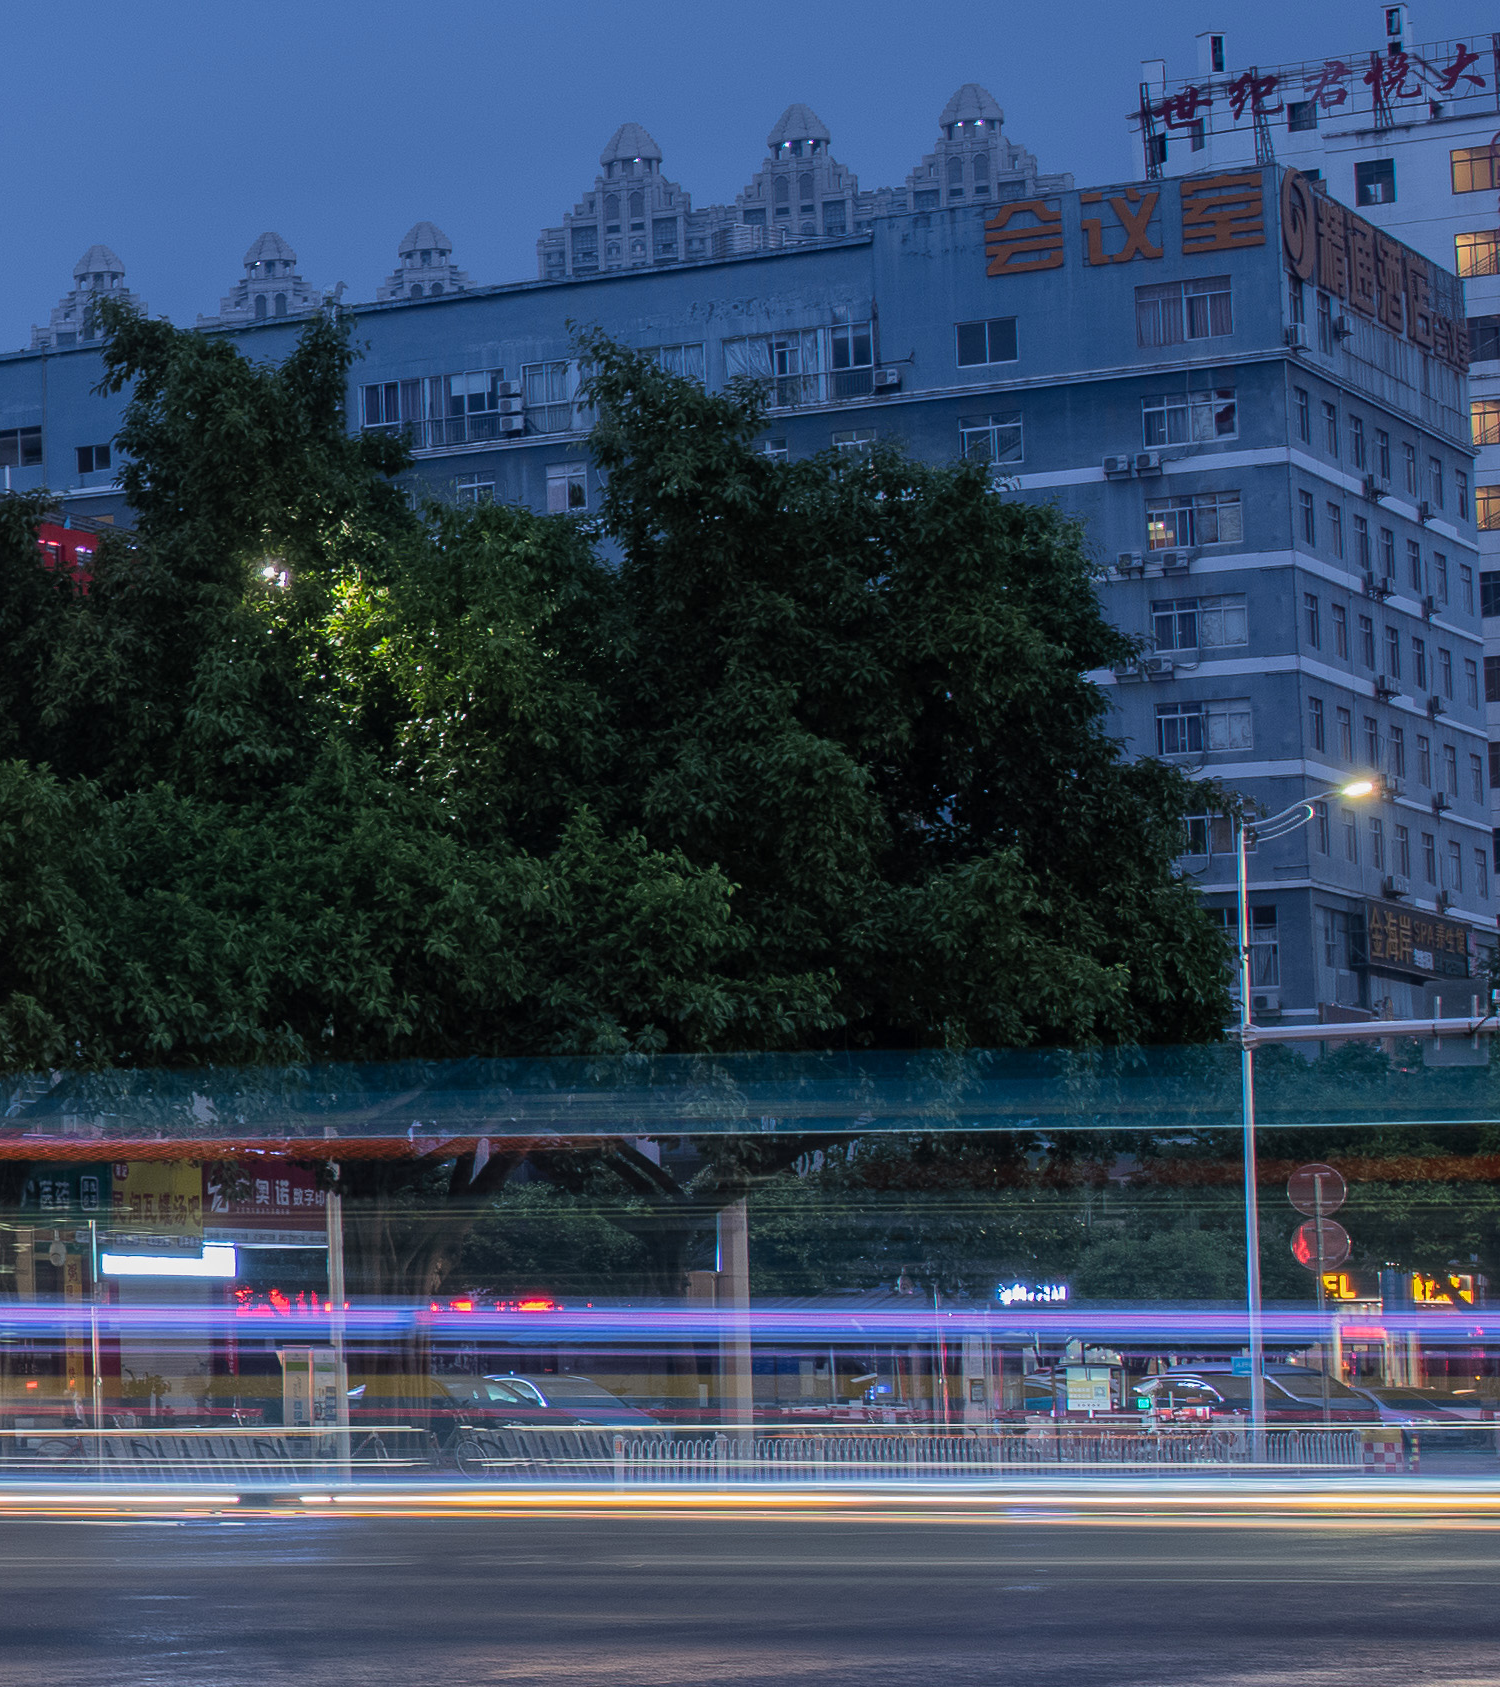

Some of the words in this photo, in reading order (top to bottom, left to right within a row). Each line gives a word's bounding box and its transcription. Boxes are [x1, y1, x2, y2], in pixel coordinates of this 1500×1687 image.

[1151, 43, 1486, 129] 世纪君悦大
[984, 172, 1267, 277] 会议室
[1369, 906, 1413, 965] 金海岸
